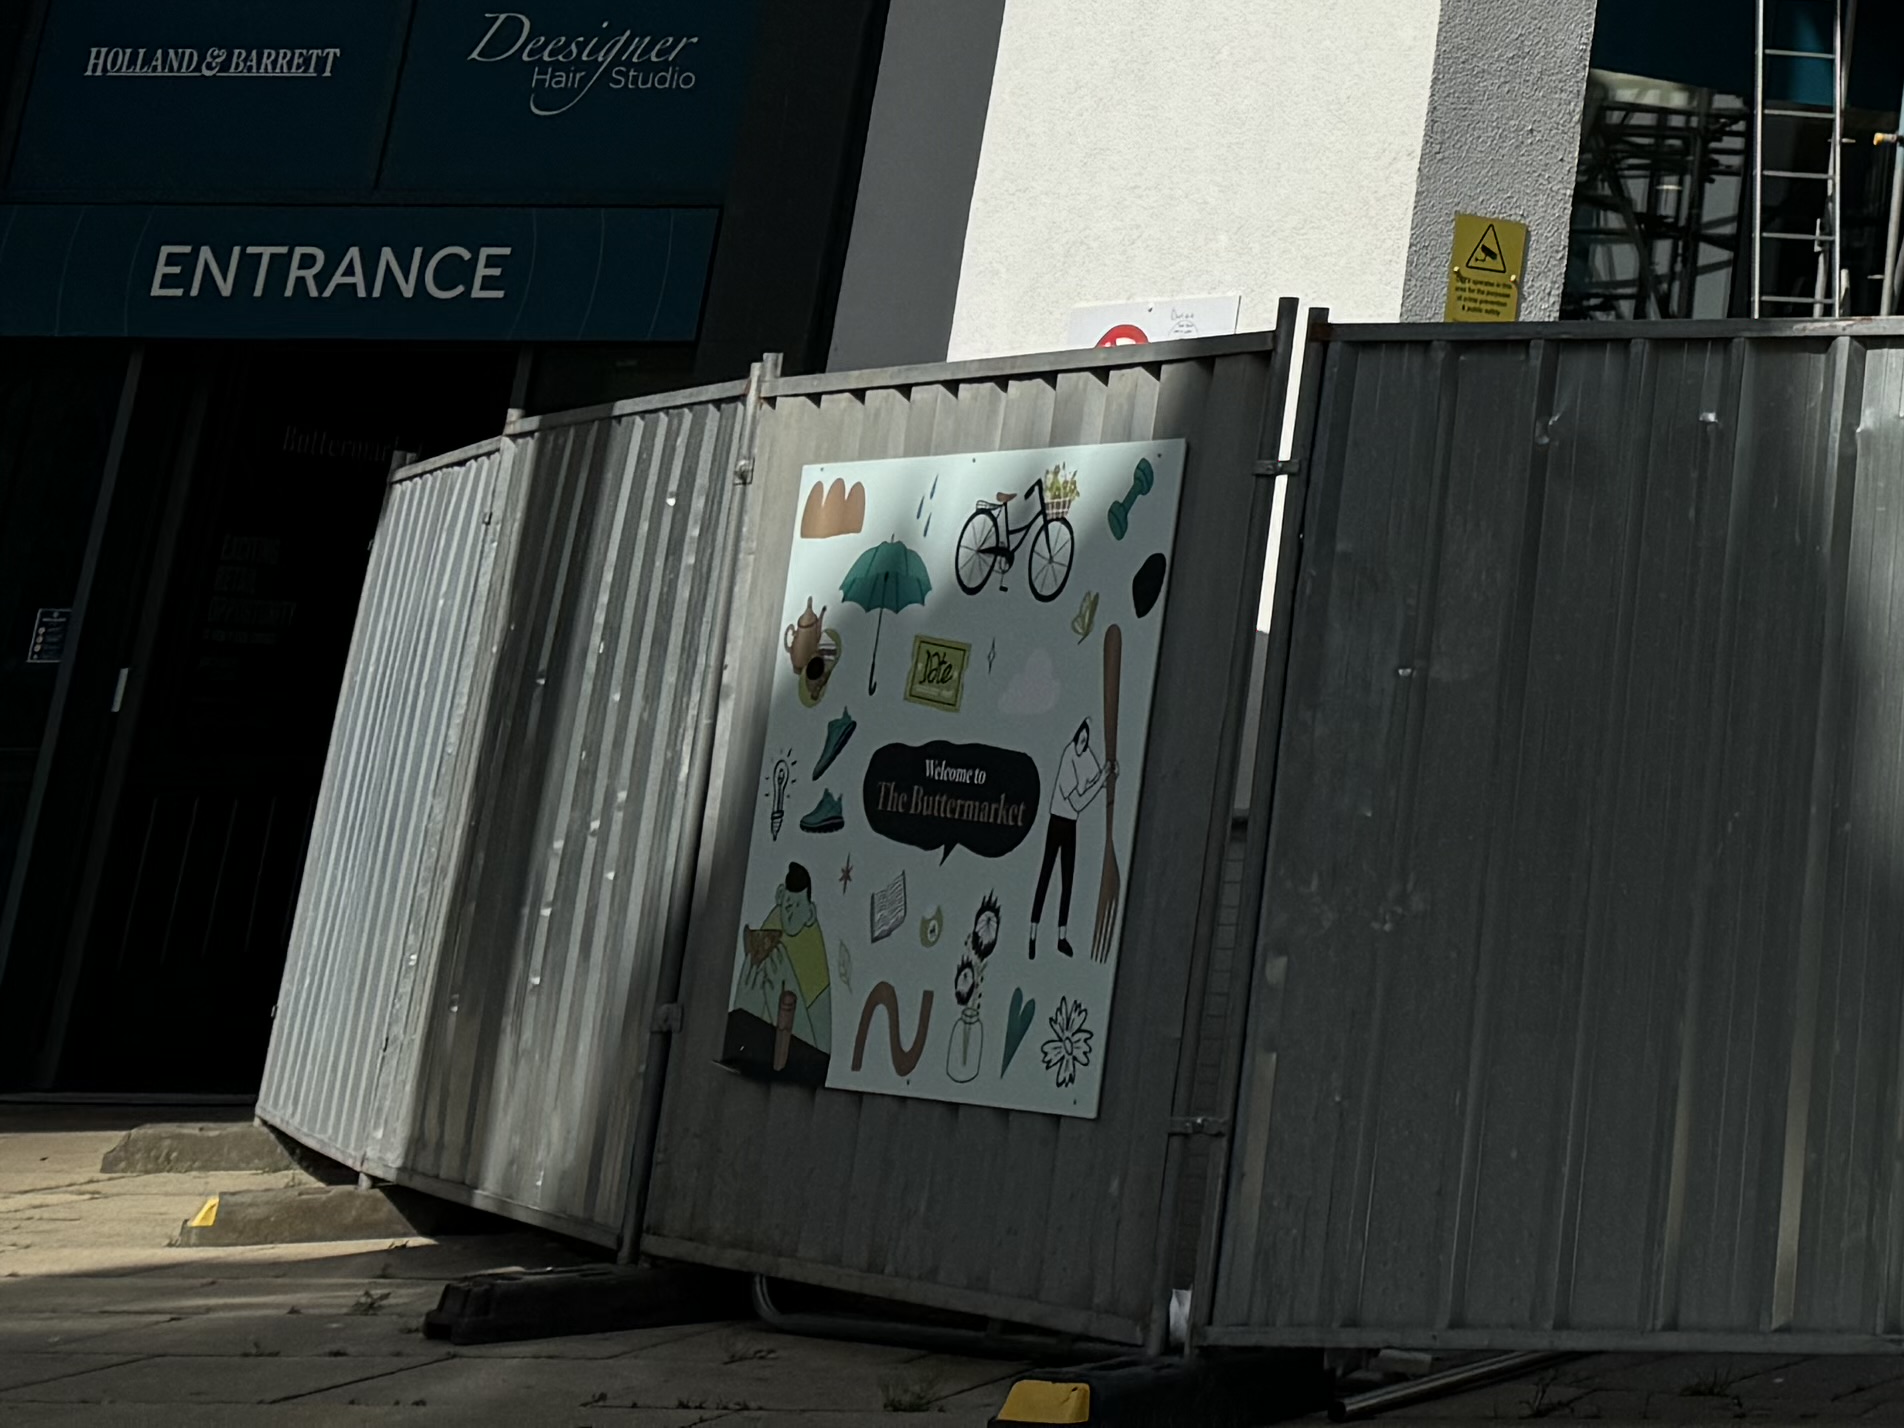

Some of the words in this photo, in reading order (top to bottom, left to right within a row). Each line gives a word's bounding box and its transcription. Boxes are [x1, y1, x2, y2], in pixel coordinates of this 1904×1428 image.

[84, 47, 199, 76] HOLLAND
[201, 47, 227, 77] &
[229, 48, 340, 77] BARRETT
[467, 12, 699, 117] Deesigner
[531, 64, 586, 91] Hair
[609, 64, 697, 92] Studio
[150, 245, 512, 300] ENTRANCE
[925, 759, 973, 784] Welcome
[974, 768, 986, 785] to
[877, 781, 907, 813] The
[909, 785, 1027, 827] Buttermarket
